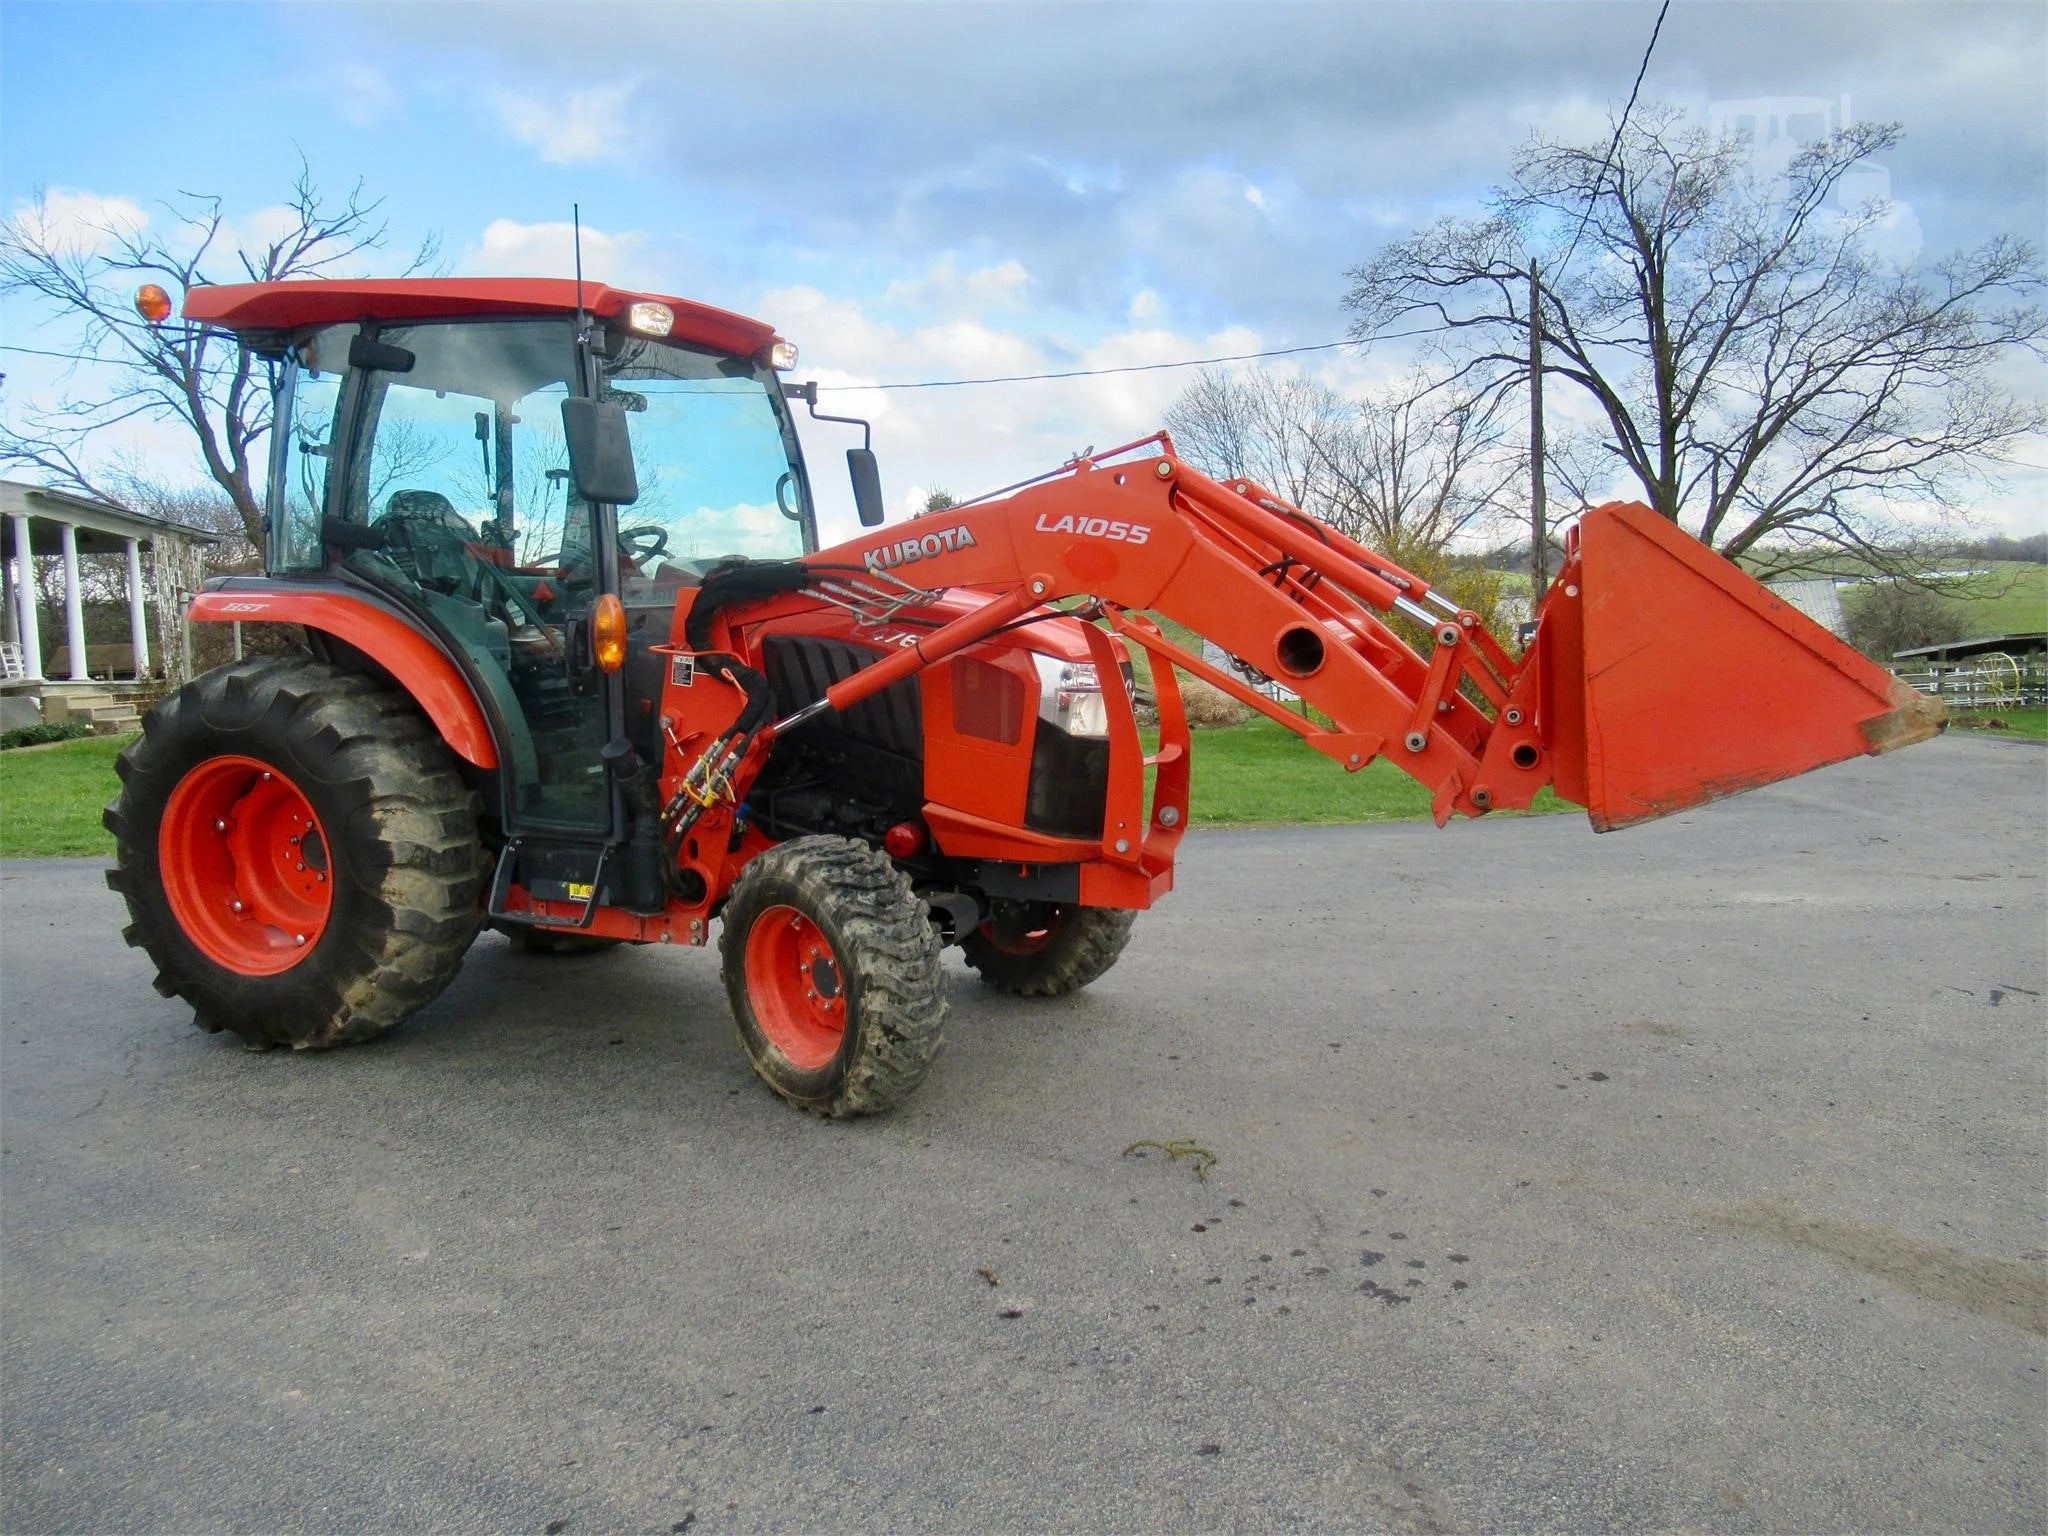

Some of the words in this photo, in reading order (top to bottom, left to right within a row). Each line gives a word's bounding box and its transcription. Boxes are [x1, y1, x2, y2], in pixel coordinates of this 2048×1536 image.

[1035, 513, 1151, 545] LA1055
[862, 524, 977, 570] KUBOTA
[223, 602, 271, 612] HST
